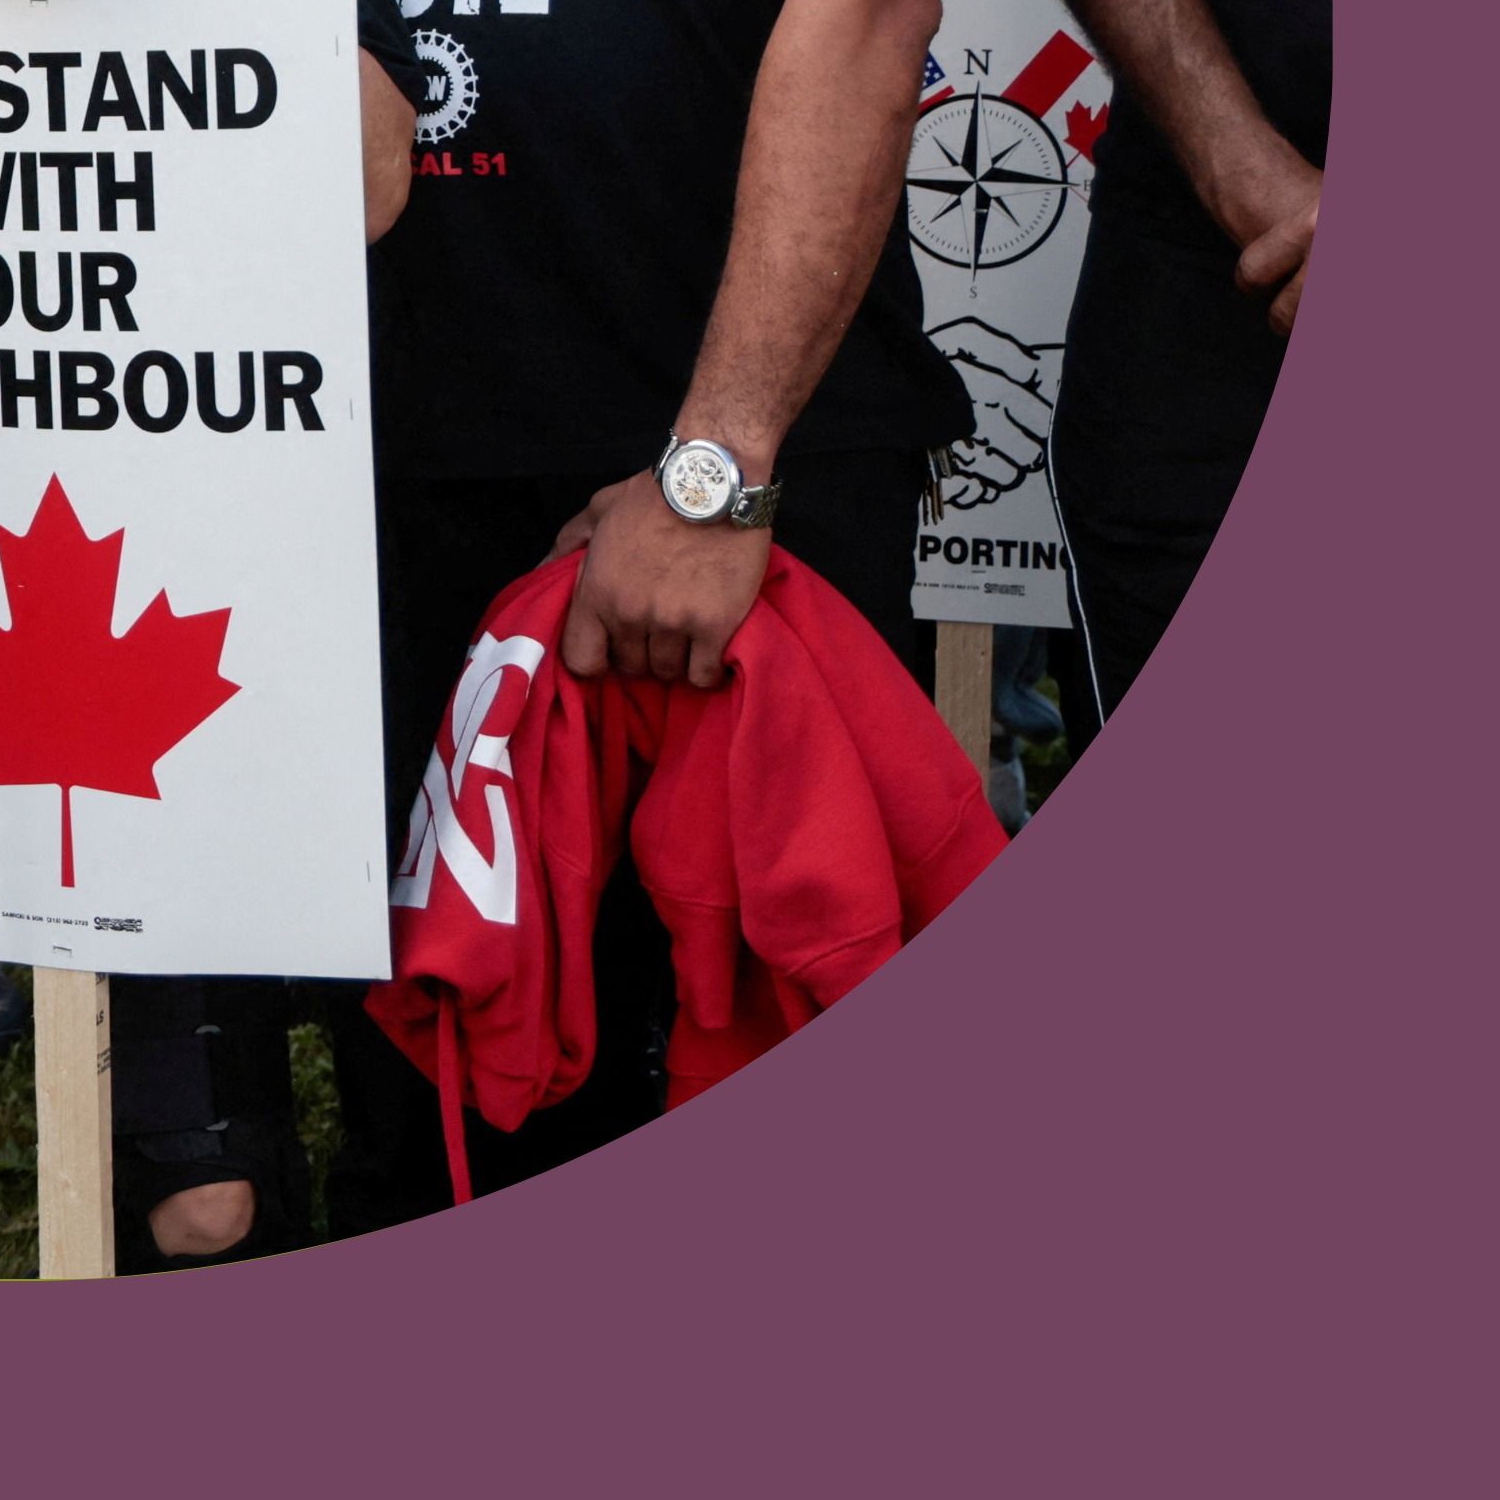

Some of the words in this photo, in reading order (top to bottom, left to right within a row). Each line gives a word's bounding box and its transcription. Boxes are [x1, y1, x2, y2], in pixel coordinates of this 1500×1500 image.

[963, 48, 992, 76] N
[472, 152, 506, 176] 51
[968, 286, 978, 300] S
